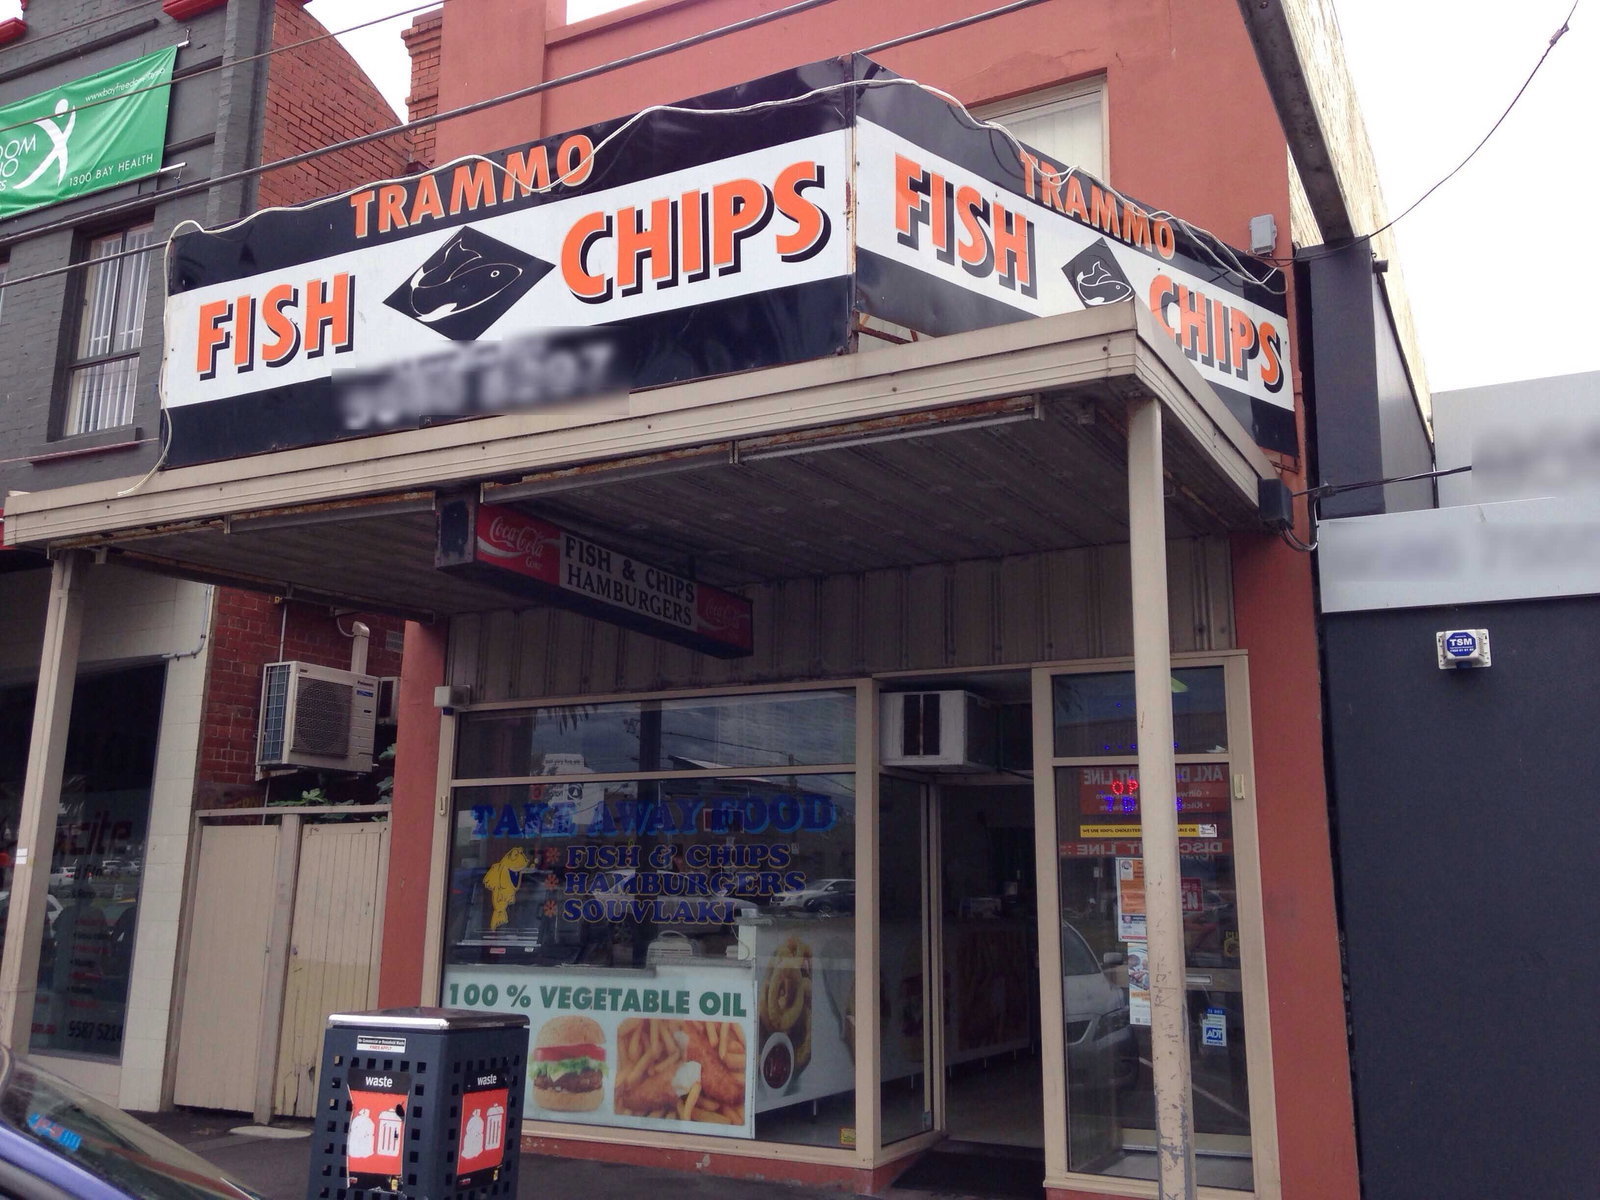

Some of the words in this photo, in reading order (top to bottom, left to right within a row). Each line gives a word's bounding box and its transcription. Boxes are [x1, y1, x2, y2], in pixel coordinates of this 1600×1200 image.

[69, 172, 92, 187] 1300
[95, 165, 114, 180] BAY
[118, 153, 154, 173] HEALTH
[350, 134, 594, 239] TRAMMO
[1019, 151, 1176, 261] TRAMMO
[196, 272, 356, 381] FISH
[560, 160, 832, 304] CHIPS
[894, 152, 1038, 300] FISH
[1149, 274, 1285, 394] CHIPS
[564, 534, 613, 575] FISH
[621, 559, 637, 583] &
[645, 566, 695, 605] CHIPS
[567, 563, 693, 627] HAMBURGERS
[1449, 638, 1473, 647] TSM
[470, 800, 577, 839] TAKE
[587, 799, 704, 837] AWAY
[709, 793, 838, 835] FOOD
[565, 844, 641, 869] FISH
[648, 843, 677, 868] &
[685, 843, 792, 869] CHIPS
[564, 871, 807, 898] HAMBURGERS
[562, 898, 739, 925] SOUVLAKI
[449, 983, 498, 1007] 100
[506, 984, 531, 1008] %
[539, 985, 691, 1015] VEGETABLE
[699, 990, 747, 1018] OIL
[1206, 1028, 1223, 1040] ADT
[365, 1075, 393, 1088] waste
[477, 1073, 497, 1086] waste
